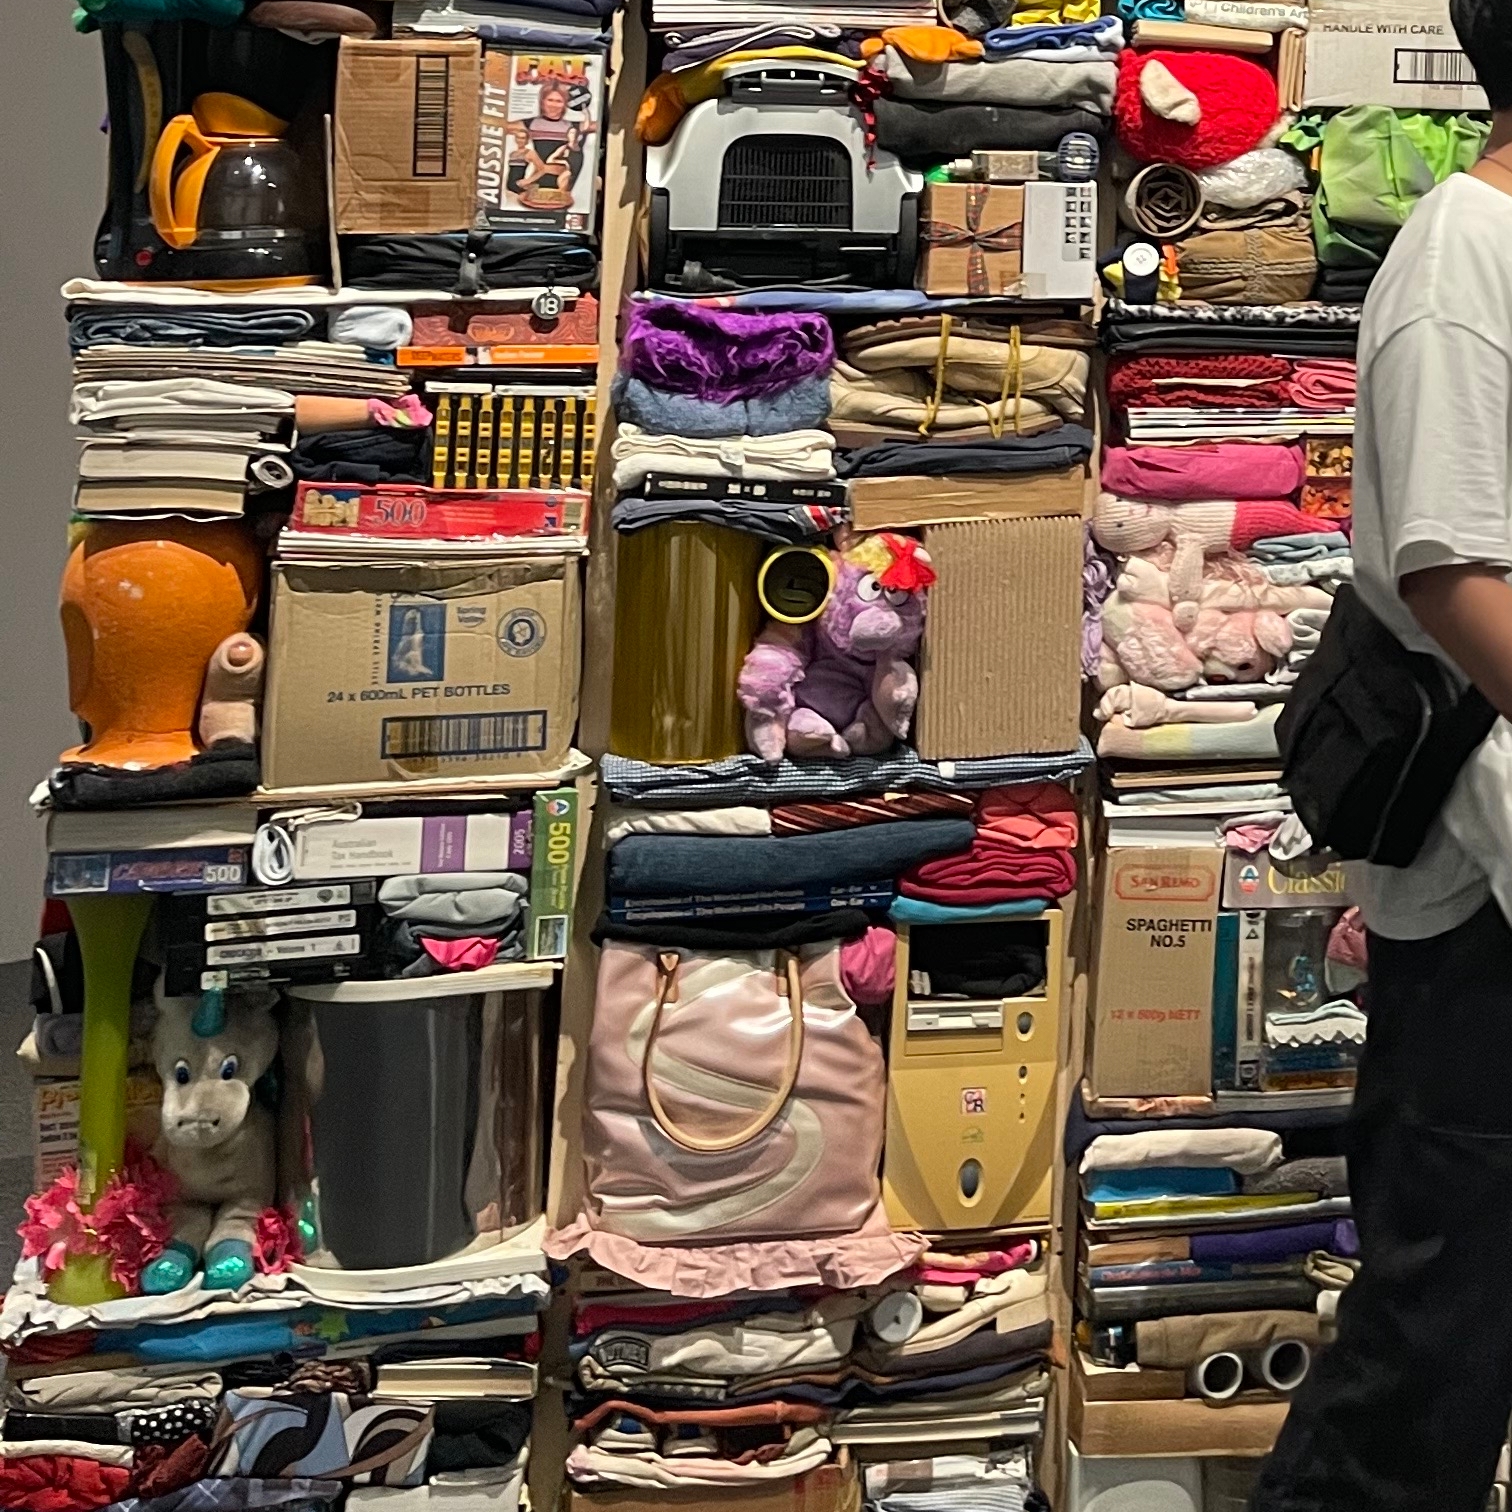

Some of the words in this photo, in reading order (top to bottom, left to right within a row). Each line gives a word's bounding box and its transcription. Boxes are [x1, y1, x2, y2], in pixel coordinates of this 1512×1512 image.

[1219, 1, 1287, 18] Children's
[1322, 23, 1373, 35] HANDLE
[1375, 23, 1408, 35] WITH
[1410, 23, 1444, 36] CARE
[483, 82, 507, 119] FIT
[476, 124, 504, 205] AUSSIE
[538, 297, 559, 316] 18
[372, 497, 427, 527] 500
[327, 690, 343, 703] 24
[411, 686, 439, 700] PET
[443, 683, 511, 697] BOTTLES
[512, 828, 526, 855] 2005
[547, 821, 571, 866] 500
[203, 865, 242, 884] 500
[1126, 917, 1212, 933] SPAGHETTI
[1150, 934, 1187, 949] NO.5
